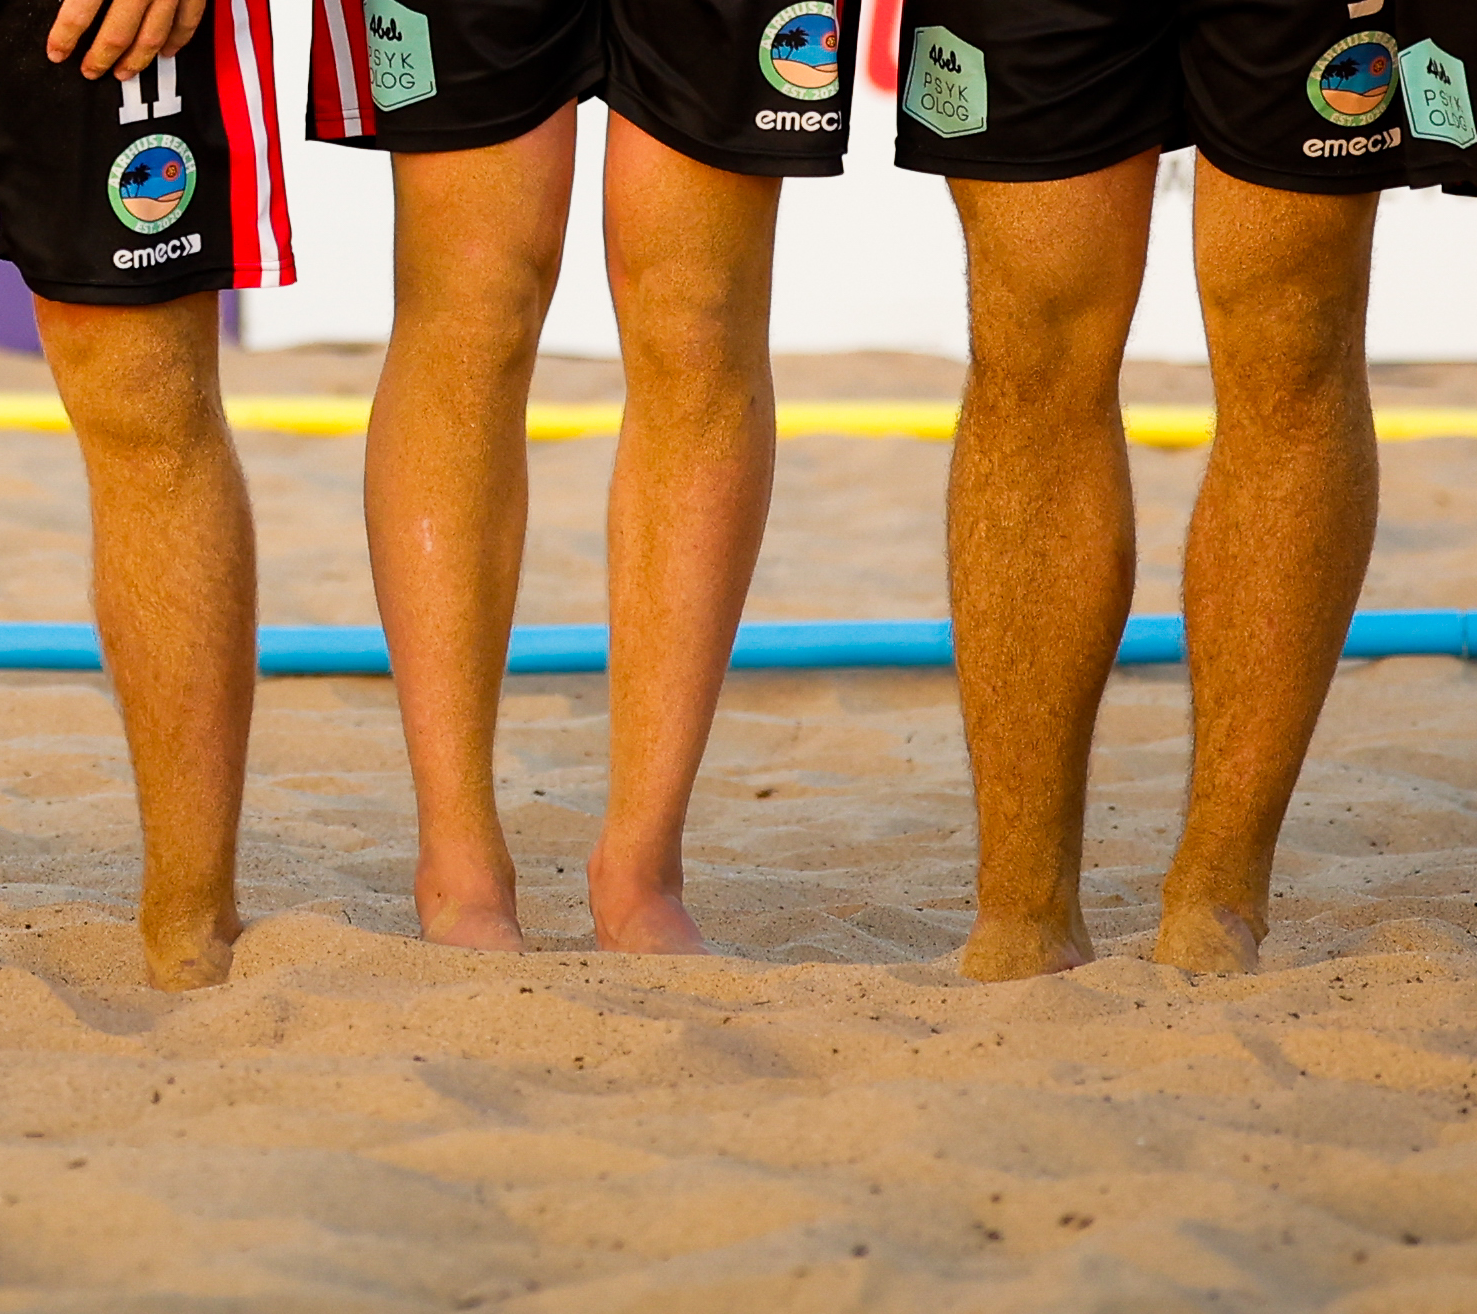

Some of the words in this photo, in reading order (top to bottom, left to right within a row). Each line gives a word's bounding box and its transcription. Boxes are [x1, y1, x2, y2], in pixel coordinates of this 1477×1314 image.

[760, 1, 820, 51] AARHUS
[924, 71, 969, 103] PSYK
[755, 110, 840, 133] emec
[921, 93, 970, 121] OLOG
[1303, 133, 1384, 158] emec
[109, 135, 158, 189] AARHUS
[161, 135, 198, 174] BEACH
[113, 239, 181, 270] emec
